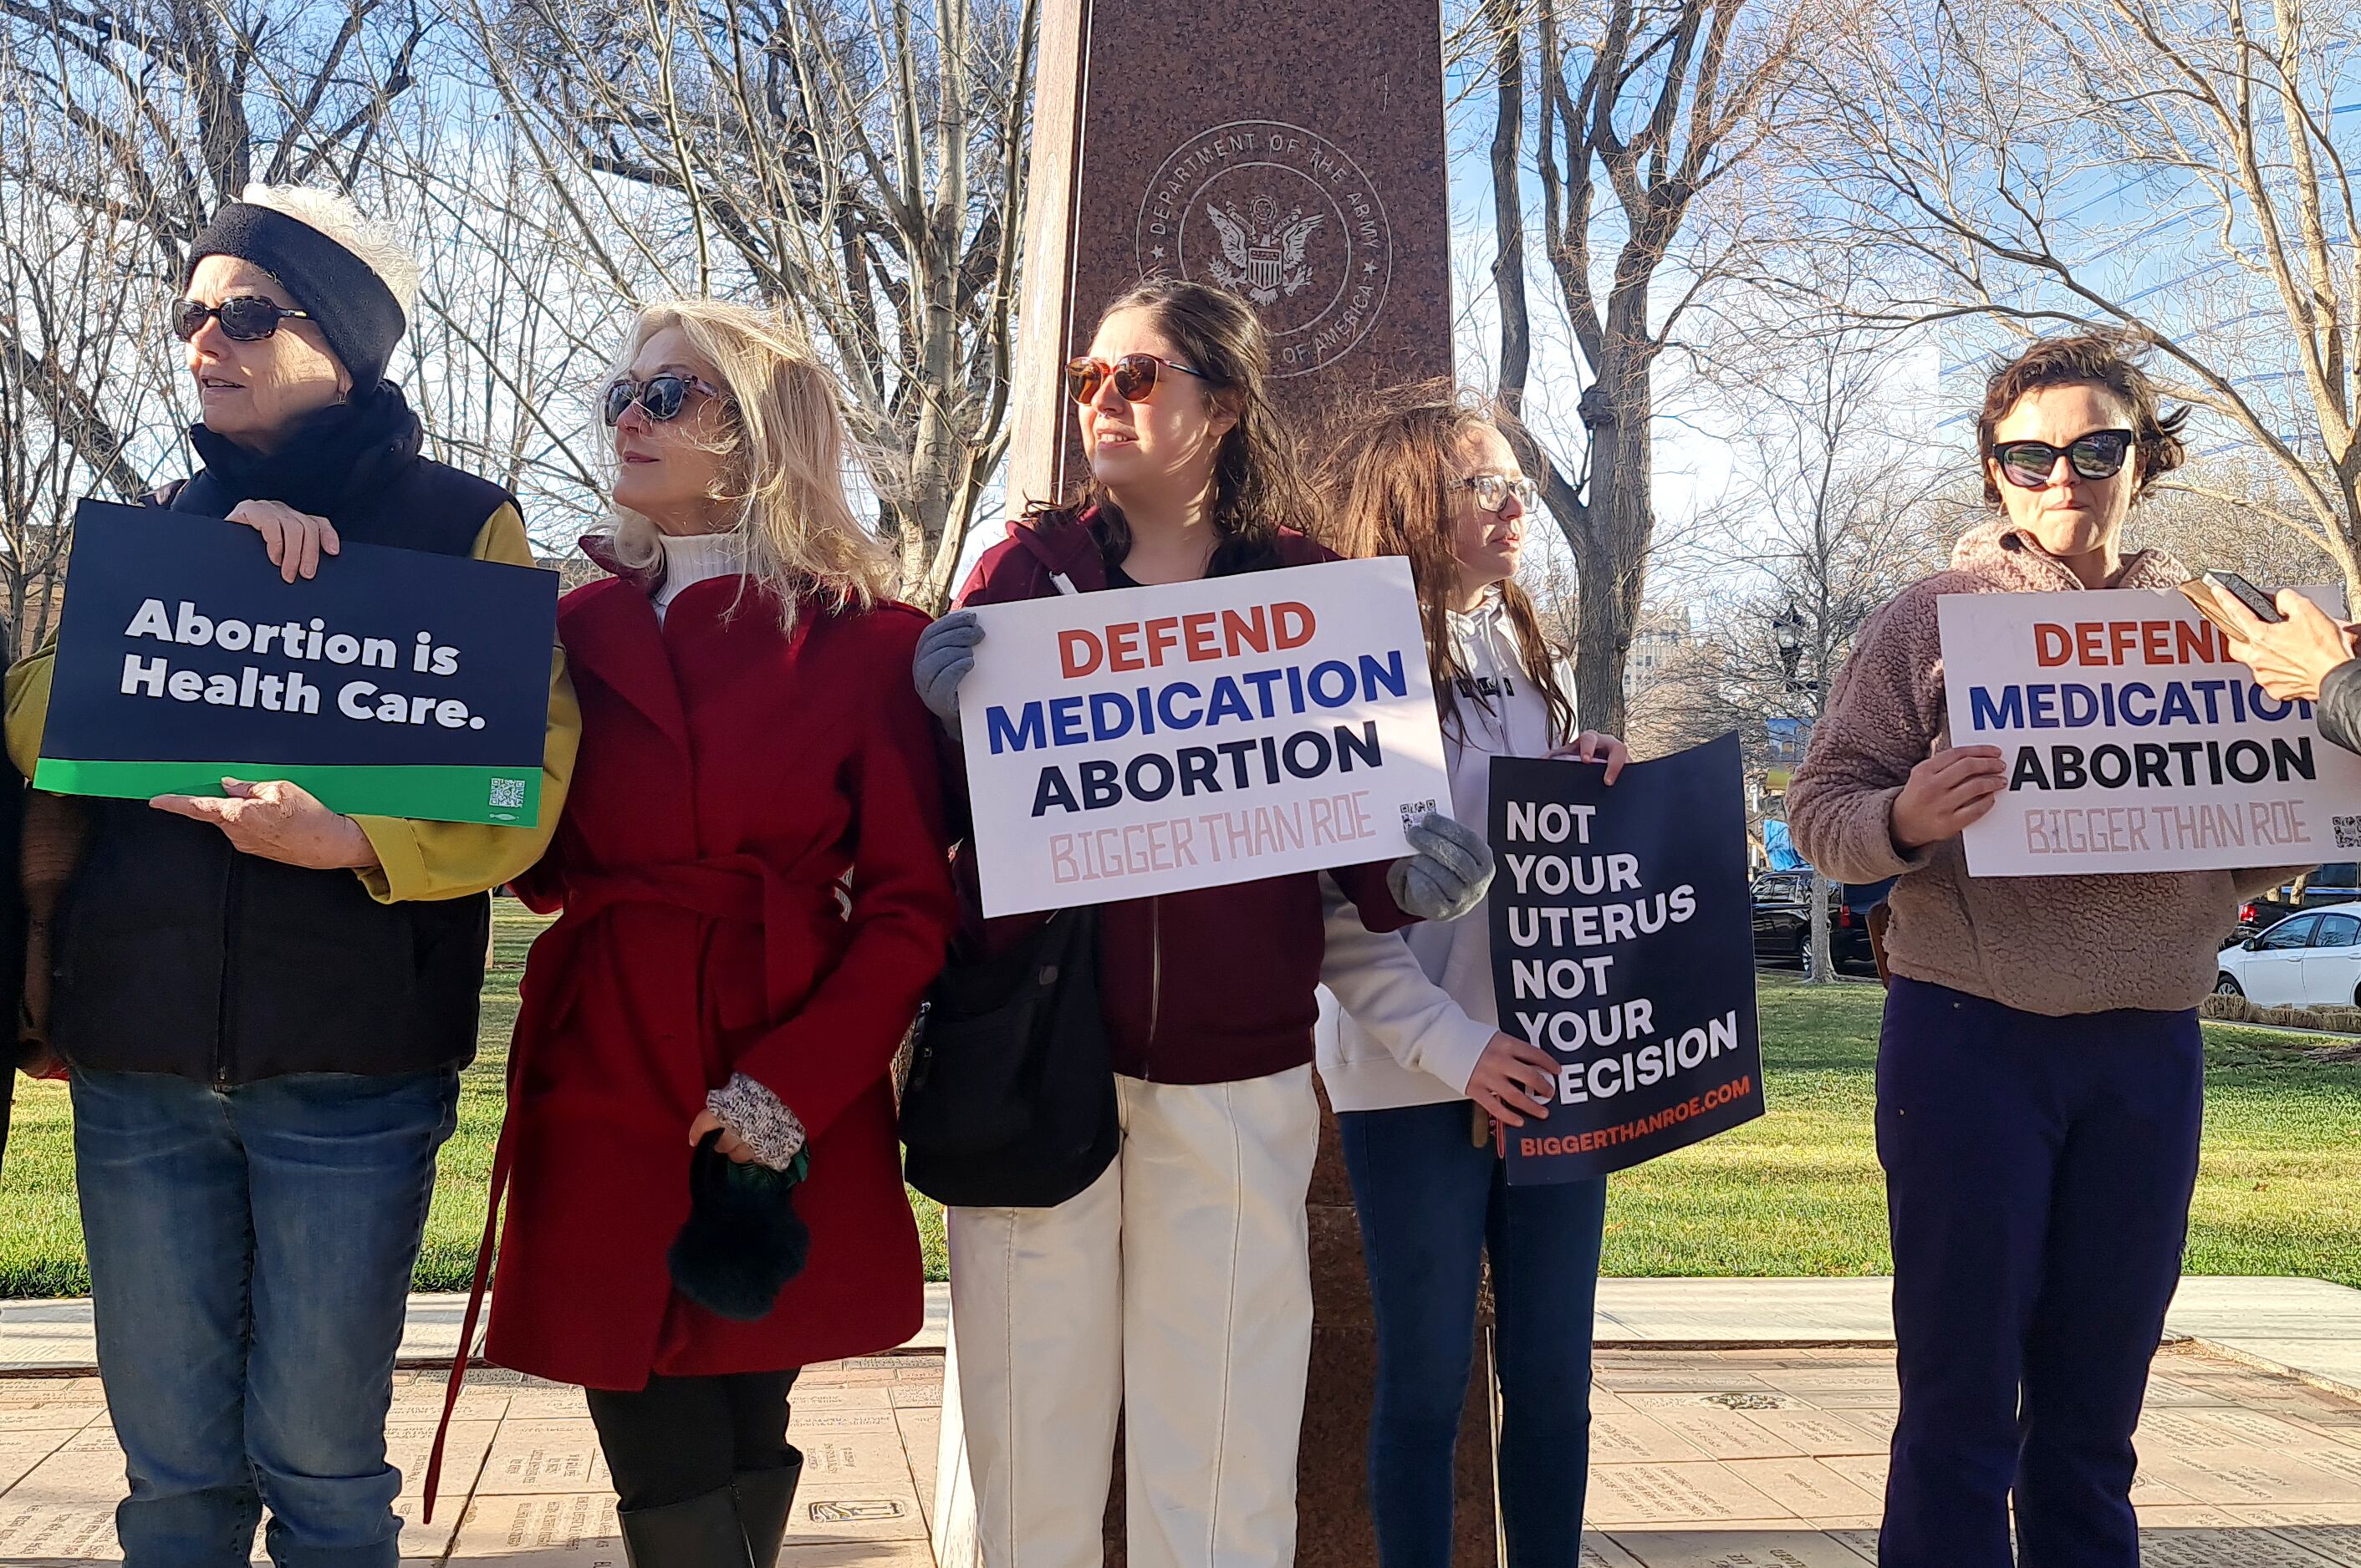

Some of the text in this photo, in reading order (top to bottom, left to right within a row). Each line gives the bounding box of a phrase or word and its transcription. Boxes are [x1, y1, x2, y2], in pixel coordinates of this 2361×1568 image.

[1150, 133, 1379, 248] DEPARTMENT OF THE ARMY
[1282, 283, 1374, 364] OF AMERICA
[125, 598, 461, 675] Abortion is
[1058, 601, 1317, 680] DEFEND
[120, 654, 487, 730] Health Care.
[985, 650, 1408, 754] MEDICATION
[1969, 680, 2313, 731] MEDICATIO
[1031, 720, 1383, 817] ABORTION
[2009, 736, 2317, 792] ABORTION
[1049, 790, 1377, 883] BIGGER THAN ROE
[1506, 801, 1597, 844] NOT
[2024, 799, 2312, 854] BIGGER THAN ROE
[1505, 853, 1642, 895] YOUR
[1507, 884, 1697, 948] UTERUS
[1512, 955, 1614, 1000] NOT
[1515, 998, 1655, 1052] YOUR
[1520, 1075, 1751, 1157] BIGGERTHANROE.COM
